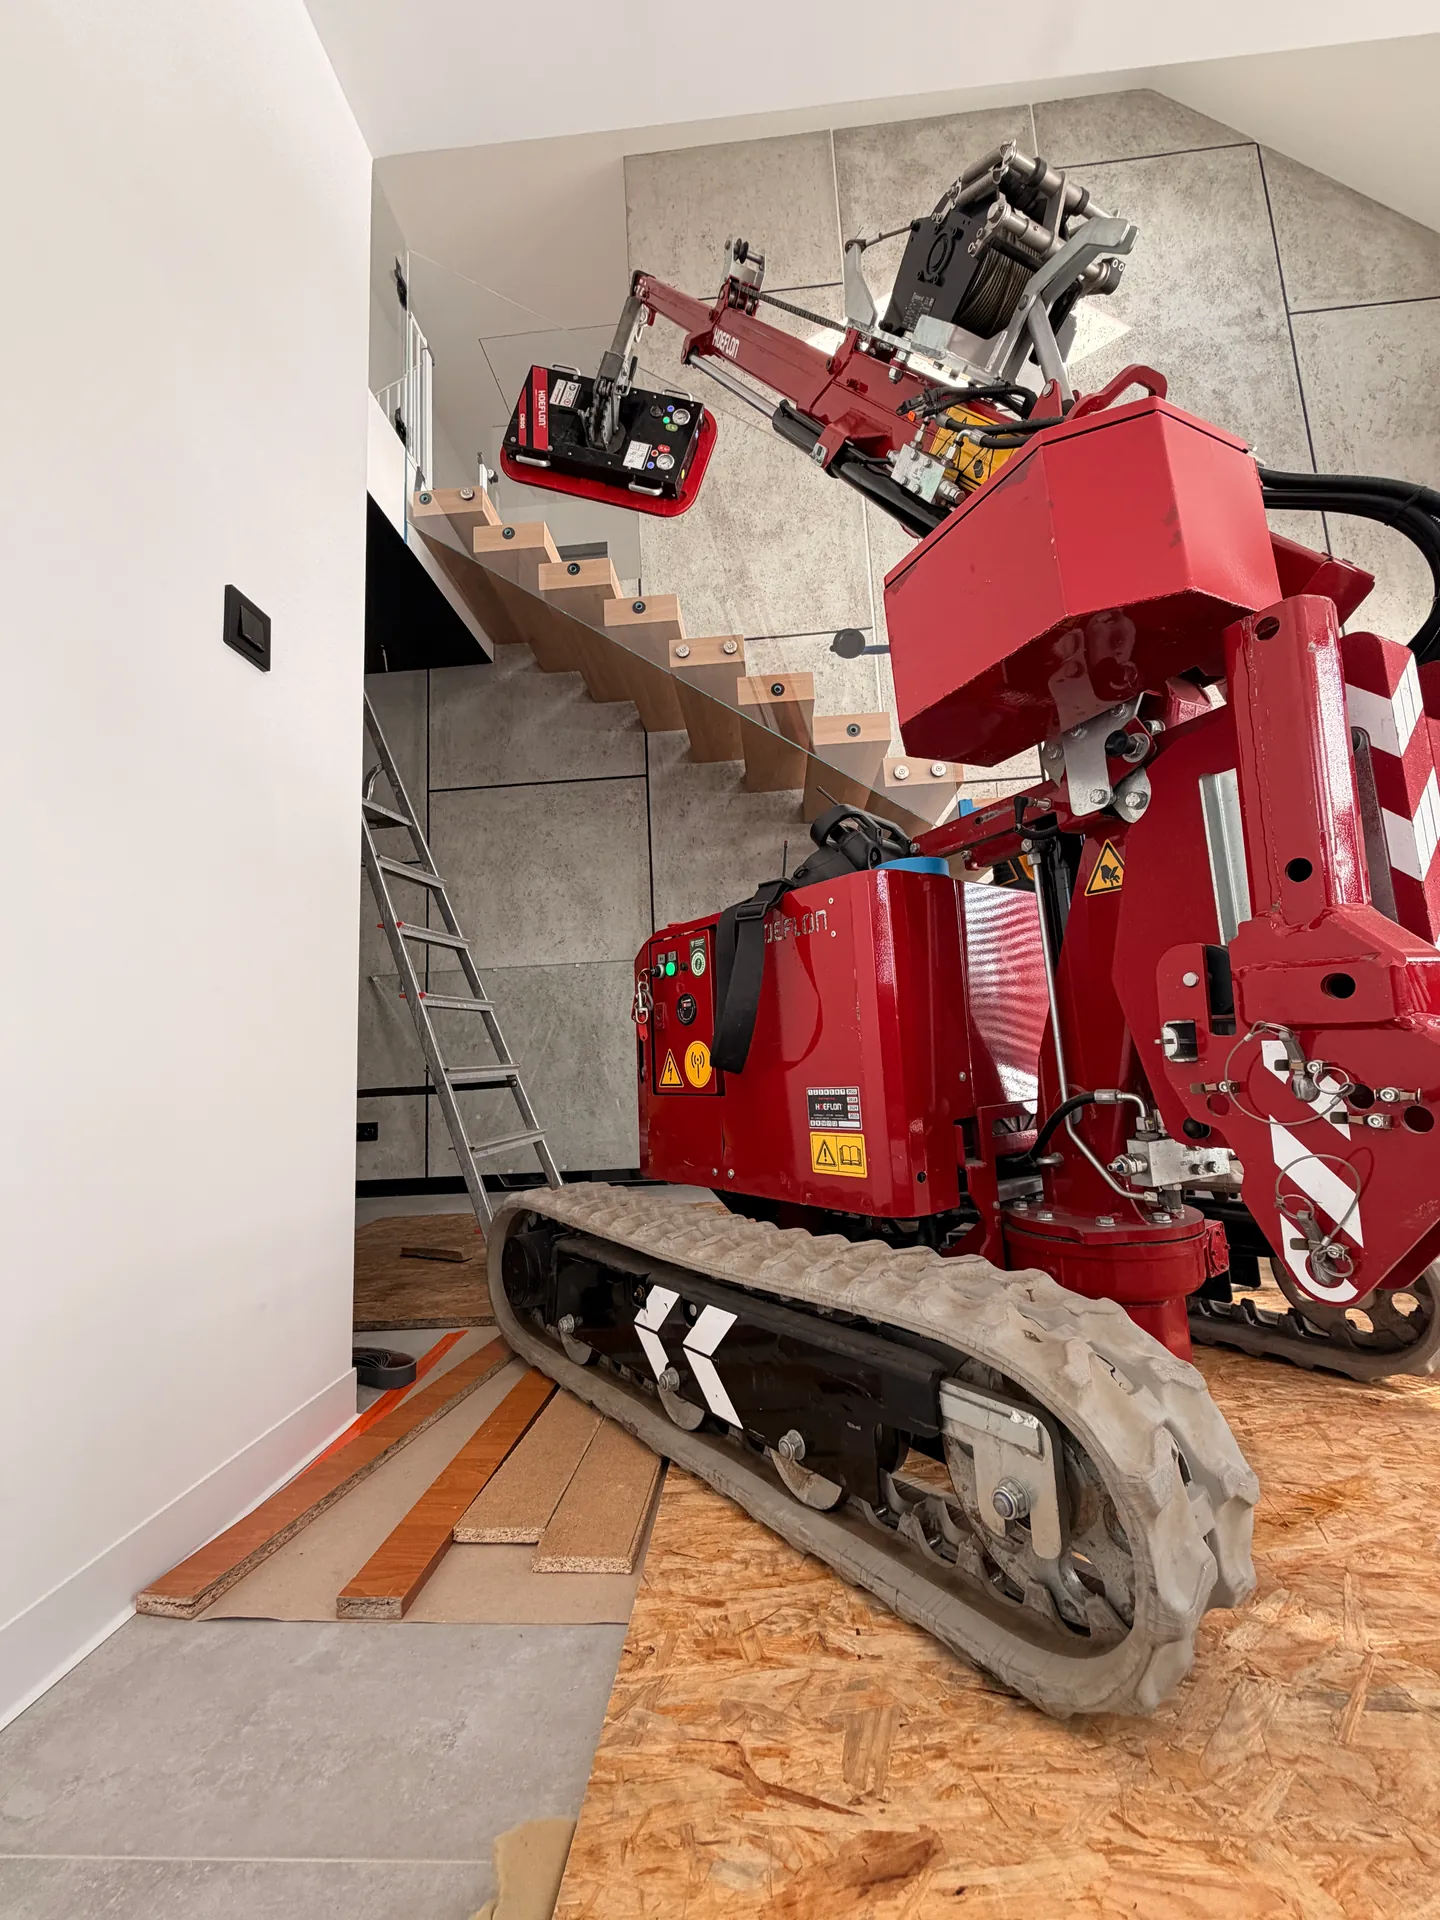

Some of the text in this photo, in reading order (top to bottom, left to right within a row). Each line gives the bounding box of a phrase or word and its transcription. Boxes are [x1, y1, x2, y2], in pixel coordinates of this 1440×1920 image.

[711, 328, 740, 359] HOEFLON
[538, 390, 547, 427] HOEFLON
[764, 909, 828, 944] OEFLON
